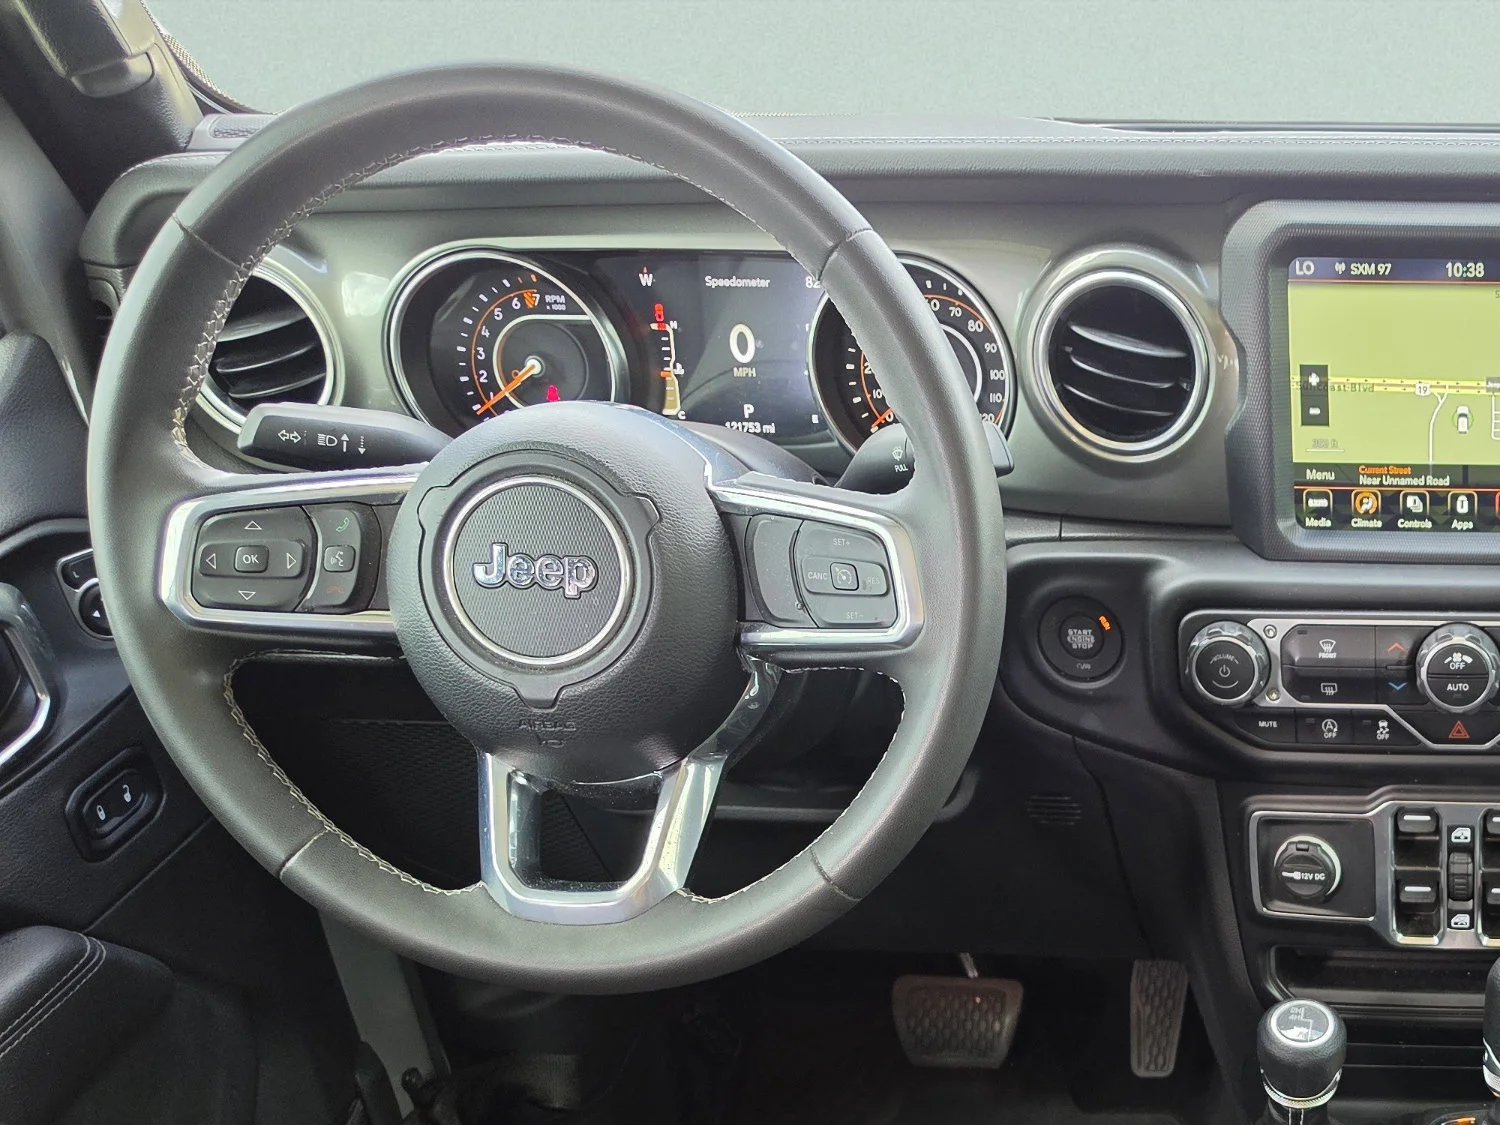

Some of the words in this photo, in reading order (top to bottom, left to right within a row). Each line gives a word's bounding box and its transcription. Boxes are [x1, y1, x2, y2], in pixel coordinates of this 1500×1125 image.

[1295, 260, 1315, 275] LO
[1350, 262, 1376, 275] SXM
[1377, 263, 1392, 275] 97
[1445, 262, 1485, 278] 10:38
[704, 275, 771, 289] Speedometer
[511, 297, 521, 310] 6
[545, 294, 566, 304] RPM
[493, 307, 503, 320] 5
[949, 307, 962, 317] 70
[481, 325, 490, 338] 4
[967, 320, 984, 333] 80
[476, 346, 486, 360] 3
[984, 342, 998, 354] 90
[478, 370, 489, 383] 2
[733, 367, 757, 378] MPH
[989, 370, 1006, 380] 100
[1417, 385, 1429, 395] 19
[989, 393, 1003, 402] 110
[743, 404, 755, 419] P
[762, 423, 776, 433] mi
[894, 465, 909, 473] PULL
[1358, 465, 1387, 475] Current
[1389, 466, 1411, 475] Street
[1306, 469, 1335, 481] Menu
[1359, 475, 1381, 486] Near
[1382, 475, 1424, 486] Unnamed
[1426, 475, 1450, 486] Road
[1305, 517, 1332, 527] Media
[1351, 518, 1382, 528] Climate
[1397, 518, 1432, 529] Controls
[1451, 519, 1474, 531] Apps
[243, 554, 259, 563] OK
[473, 542, 597, 598] Jeep
[808, 571, 828, 580] CANC
[1446, 682, 1470, 692] AUTO
[1258, 720, 1278, 728] MUTE
[1323, 731, 1337, 739] OFF
[1376, 731, 1390, 740] OFF
[1301, 872, 1313, 880] 12V
[1314, 872, 1326, 880] DC
